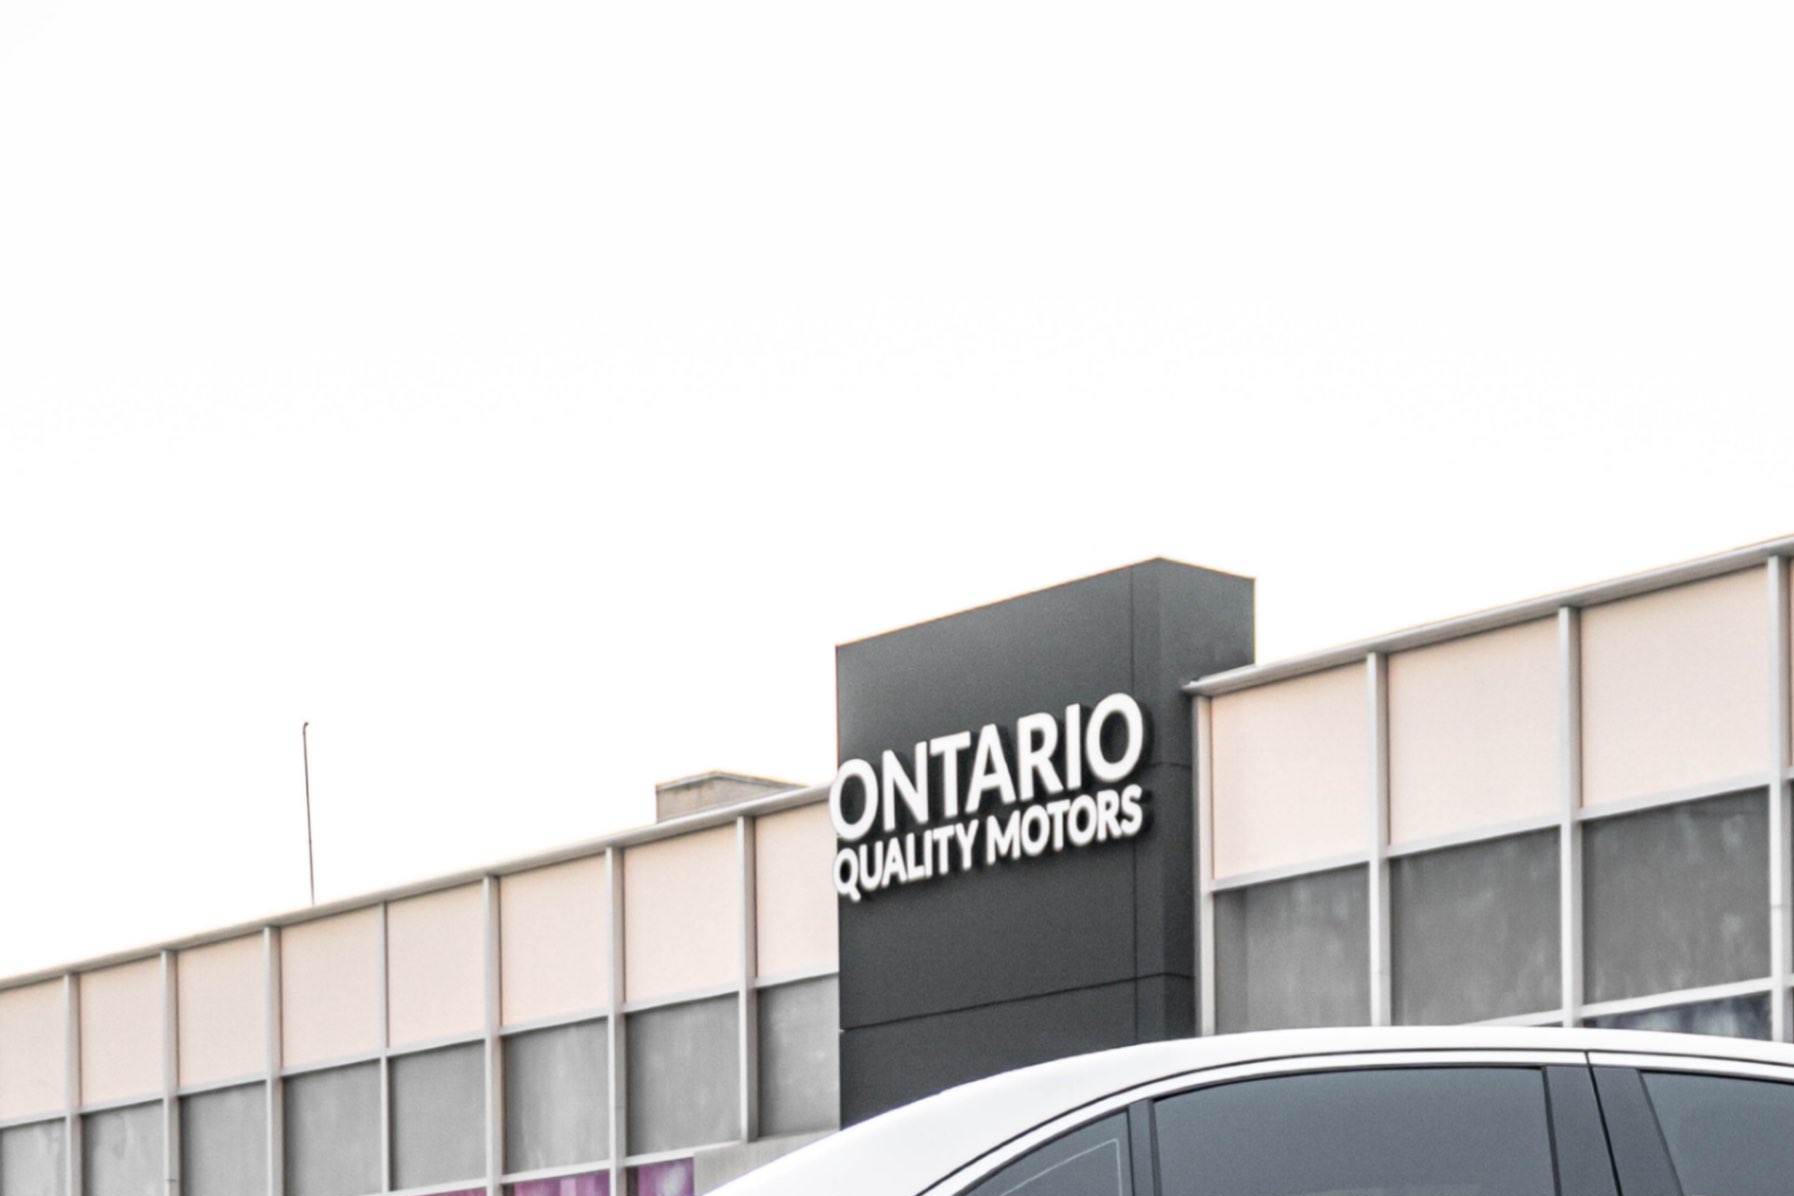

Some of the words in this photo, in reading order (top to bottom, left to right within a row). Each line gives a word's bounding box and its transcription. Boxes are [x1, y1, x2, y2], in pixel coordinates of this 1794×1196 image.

[829, 693, 1143, 840] ONTARIO
[833, 820, 979, 901] QUALITY
[987, 785, 1143, 865] MOTORS
